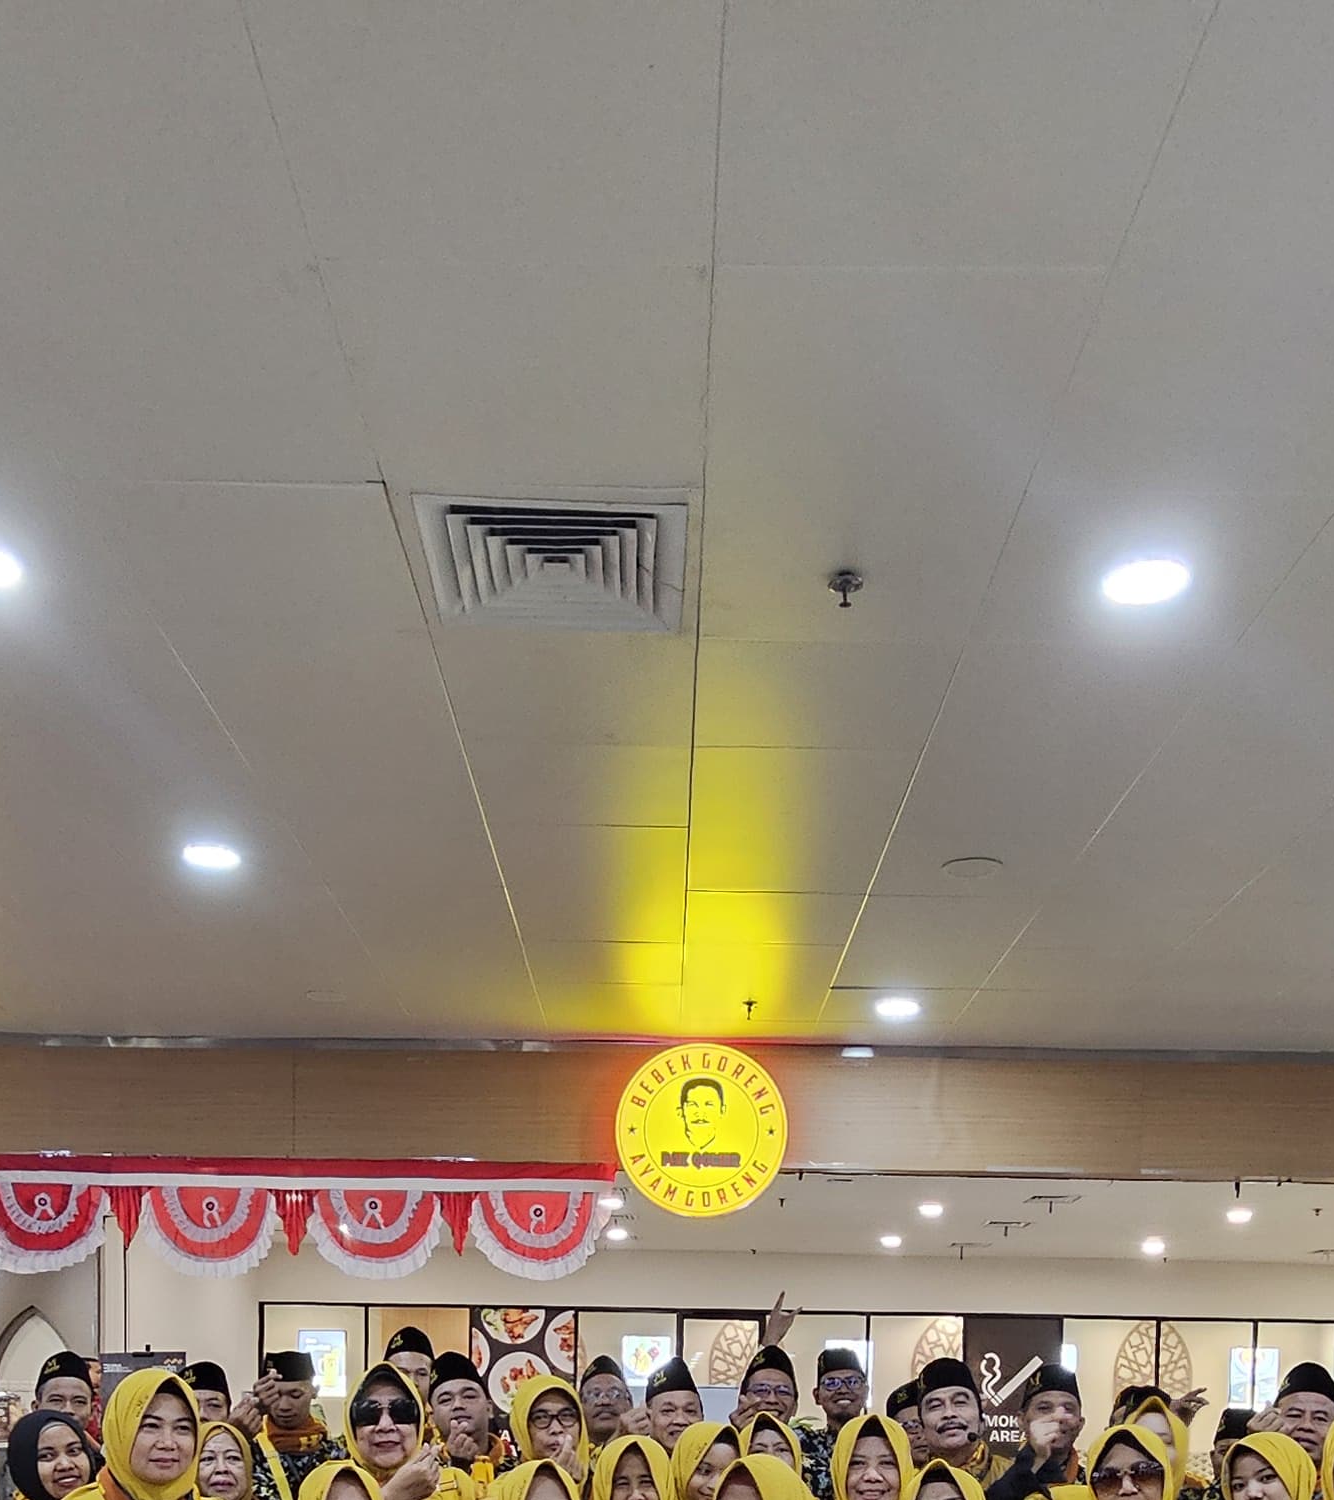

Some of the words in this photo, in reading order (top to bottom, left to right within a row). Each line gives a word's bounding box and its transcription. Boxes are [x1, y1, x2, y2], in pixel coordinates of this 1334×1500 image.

[631, 1054, 692, 1108] BEBEK
[702, 1053, 775, 1116] GORENG
[629, 1153, 679, 1202] AYAM
[685, 1160, 769, 1208] GORENG
